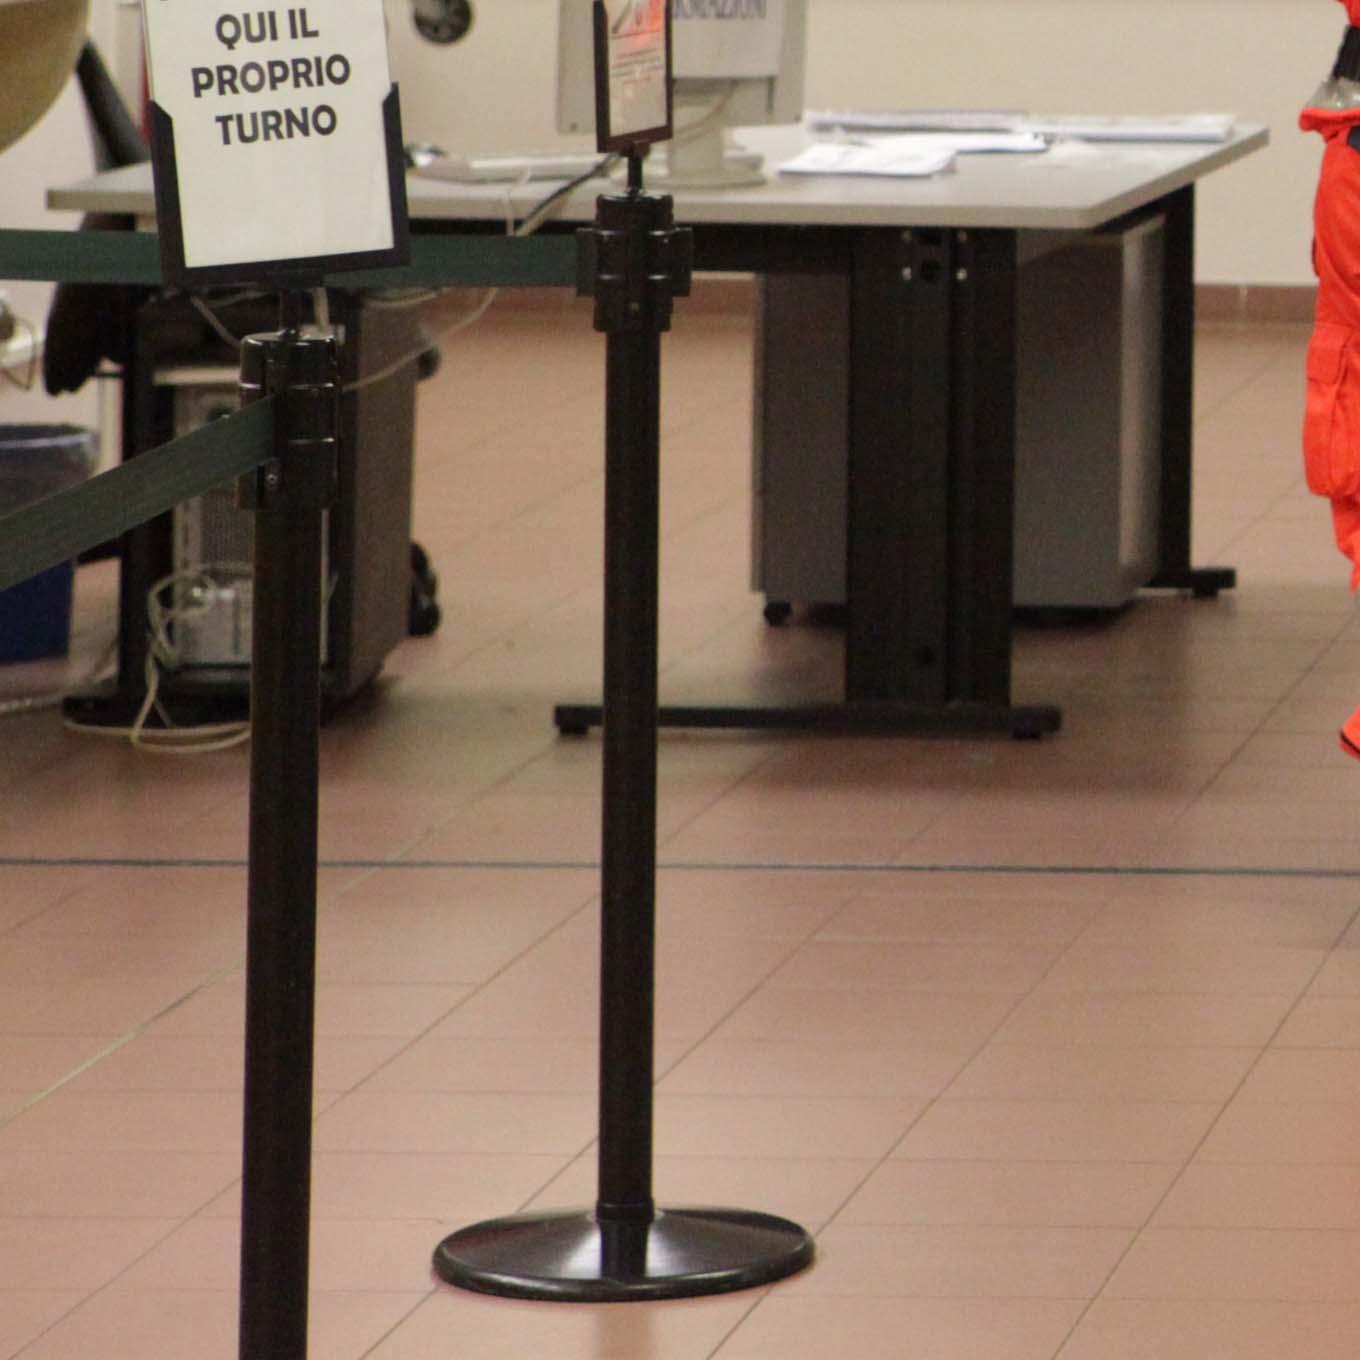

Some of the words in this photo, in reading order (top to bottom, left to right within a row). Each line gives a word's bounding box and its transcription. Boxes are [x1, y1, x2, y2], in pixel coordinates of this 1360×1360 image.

[215, 9, 278, 51] QUI
[288, 7, 320, 40] IL
[191, 53, 352, 99] PROPRIO
[215, 103, 338, 146] TURNO
